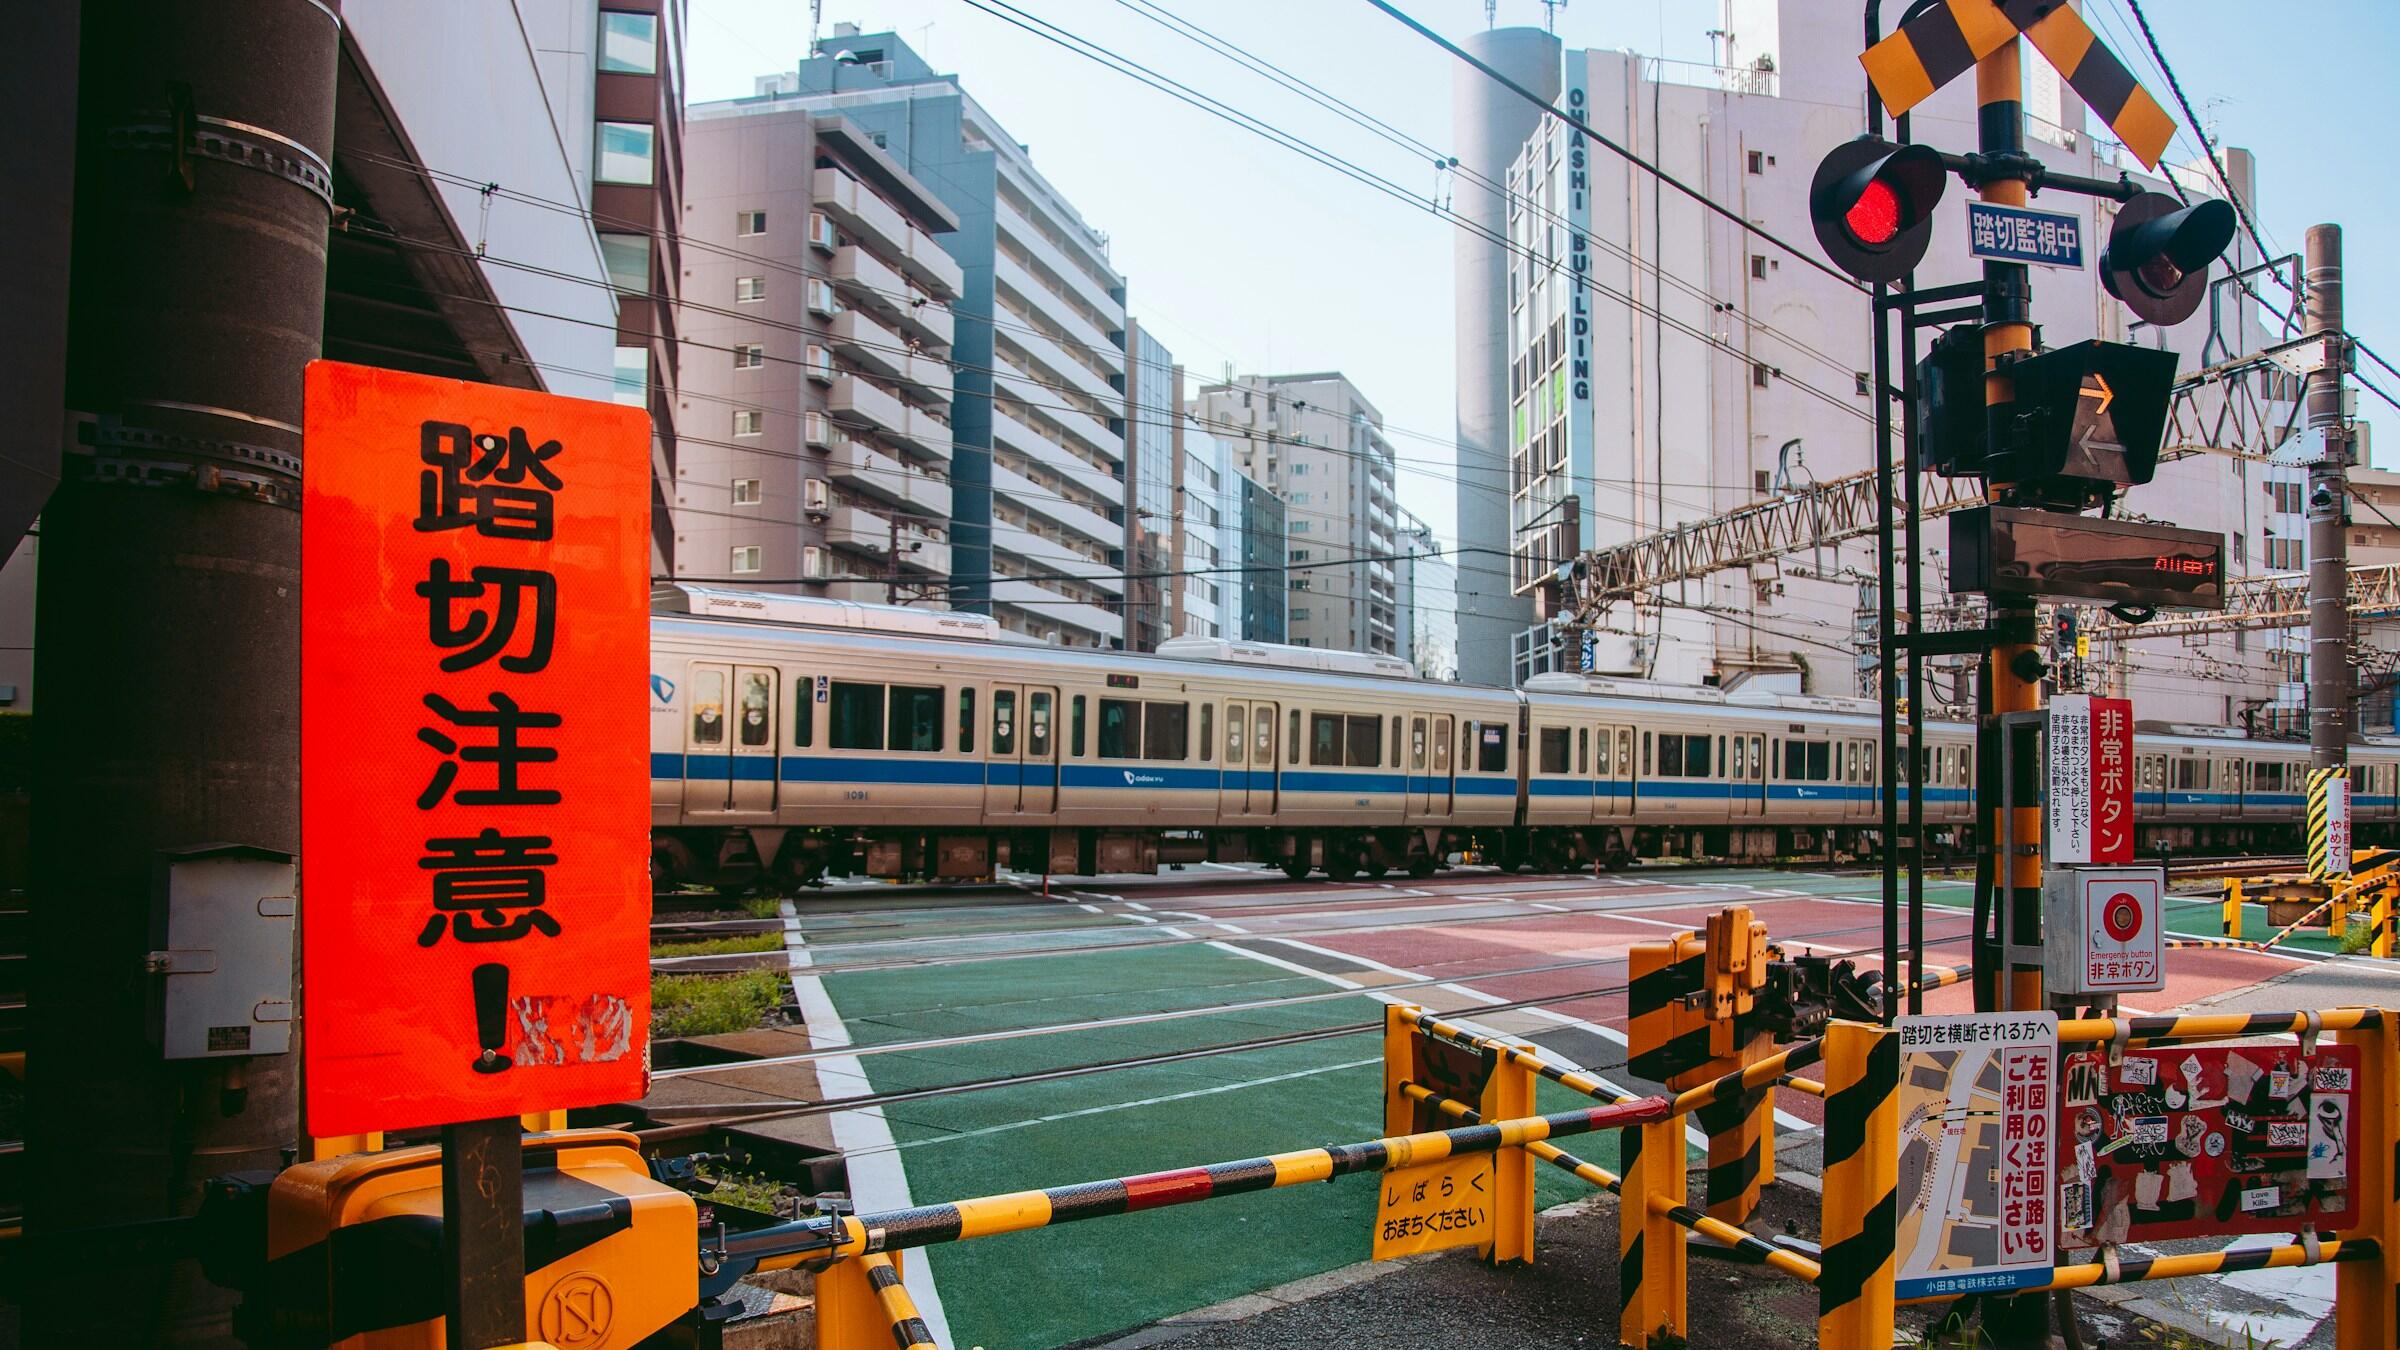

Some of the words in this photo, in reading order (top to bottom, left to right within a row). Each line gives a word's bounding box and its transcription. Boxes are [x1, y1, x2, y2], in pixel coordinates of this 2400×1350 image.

[1570, 88, 1586, 210] OHASHI
[1973, 212, 2077, 259] 踏切監視中
[1572, 233, 1589, 401] BUILDING
[2061, 714, 2070, 797] 非常の場合以外に
[2070, 714, 2080, 854] なるまでつよく押して下さい。
[2099, 709, 2124, 853] 非常ボタン
[2090, 951, 2129, 961] Emergency
[2130, 950, 2153, 959] button
[2090, 960, 2155, 980] 非常ボタン
[1901, 1020, 2051, 1046] 踏切を横断される方へ
[2004, 1054, 2027, 1255] ご利用ください
[2025, 1054, 2048, 1254] 左図の迂回路も
[1387, 1172, 1485, 1208] しばらく
[2250, 1191, 2270, 1199] Love
[2252, 1199, 2269, 1207] Kills
[1383, 1207, 1485, 1241] おまちください
[1926, 1273, 2016, 1293] 小田急電鉄株式会社
